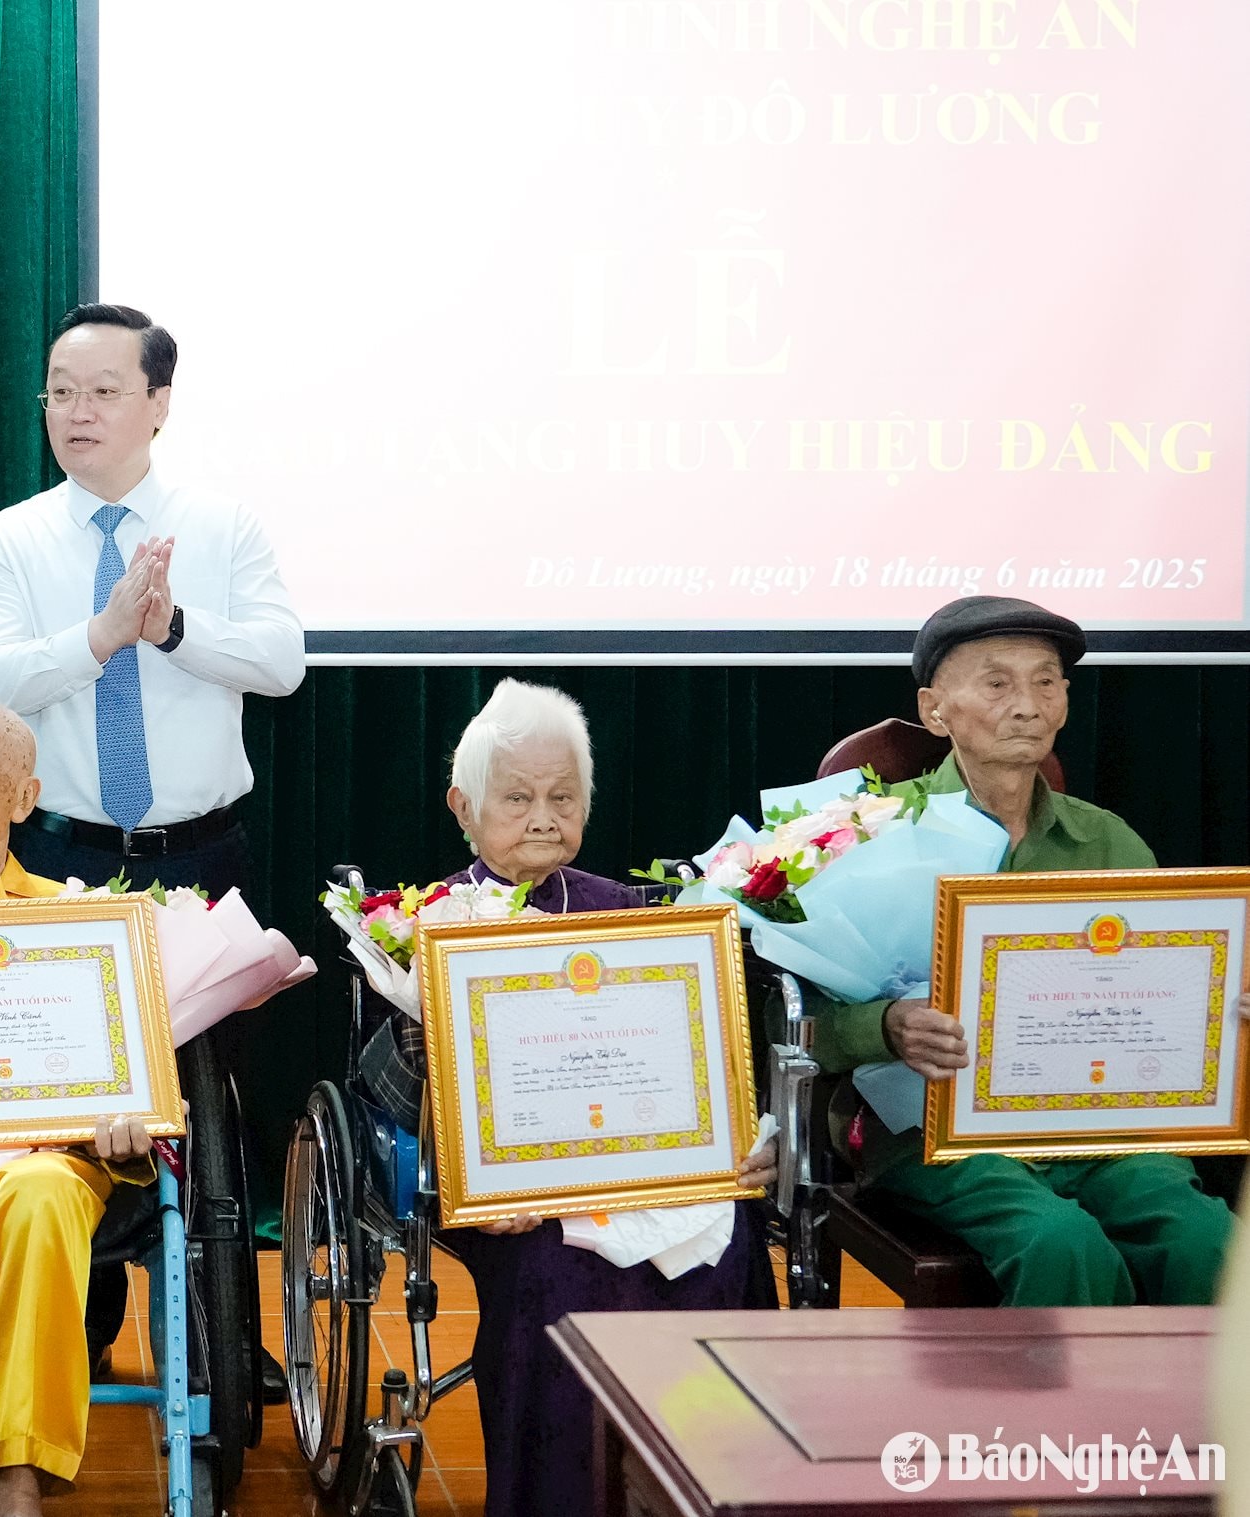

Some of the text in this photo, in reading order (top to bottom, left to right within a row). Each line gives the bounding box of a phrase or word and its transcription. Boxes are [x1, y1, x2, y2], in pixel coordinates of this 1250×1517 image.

[698, 78, 806, 147] ĐÔ
[829, 82, 1103, 147] LƯƠNG
[553, 207, 792, 376] LỄ
[605, 416, 766, 473] HUY
[784, 410, 974, 487] HIỆU
[996, 402, 1216, 474] ĐẢNG
[586, 555, 716, 598] Lương,
[728, 555, 816, 598] ngày
[829, 556, 870, 588] 18
[879, 556, 983, 597] tháng
[997, 557, 1018, 590] 6
[1029, 558, 1107, 590] năm
[1118, 558, 1208, 591] 2025
[1028, 993, 1049, 1001] HUY
[519, 1036, 539, 1045] HUY
